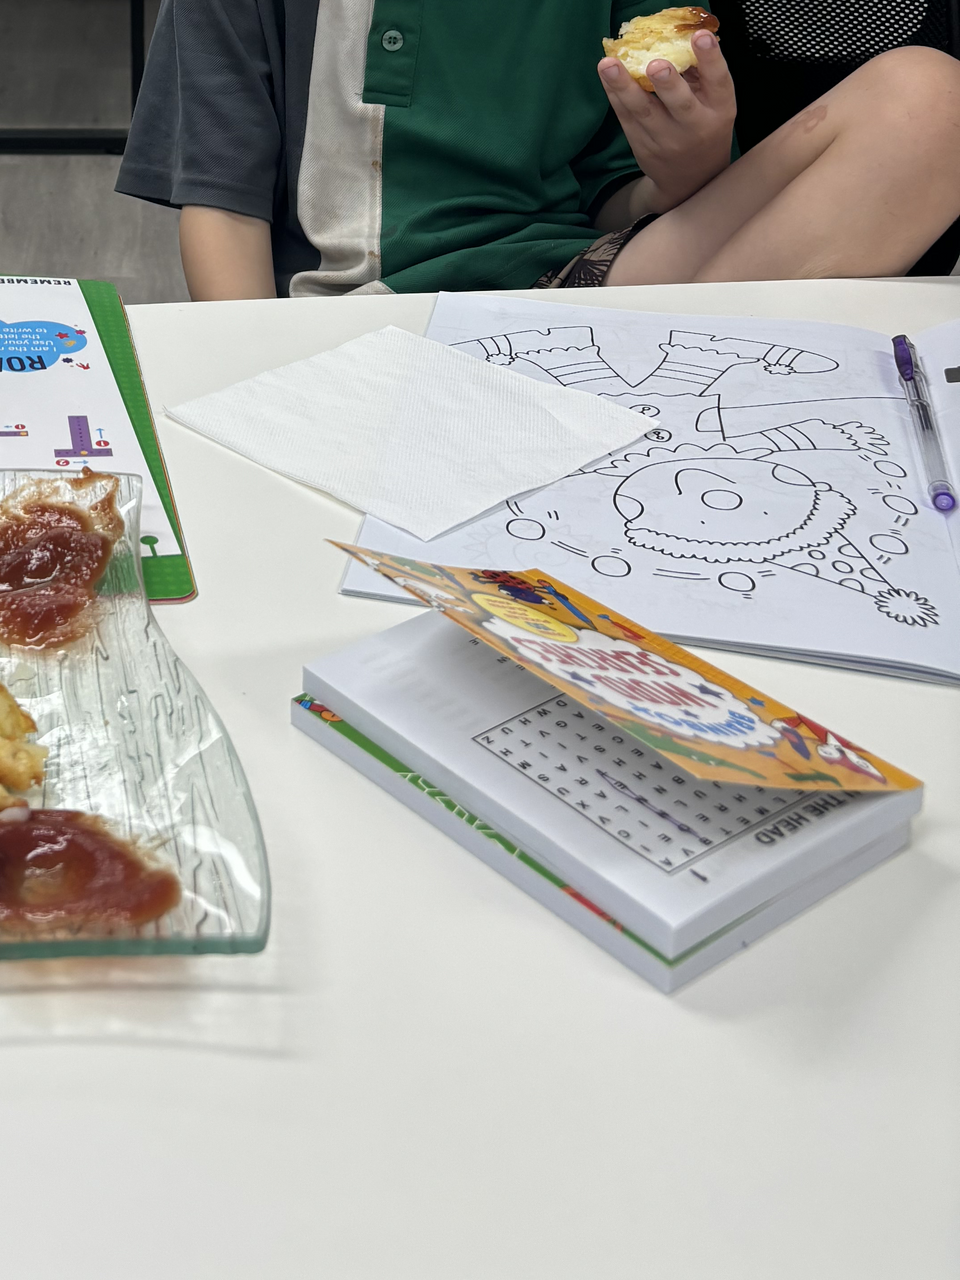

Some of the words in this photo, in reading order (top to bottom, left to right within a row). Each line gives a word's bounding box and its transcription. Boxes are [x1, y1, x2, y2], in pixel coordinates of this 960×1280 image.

[510, 636, 681, 677] SEARCHES
[590, 673, 719, 708] WORD
[626, 701, 757, 737] BRAINBOX
[802, 794, 847, 819] THE
[754, 811, 810, 846] HEAD
